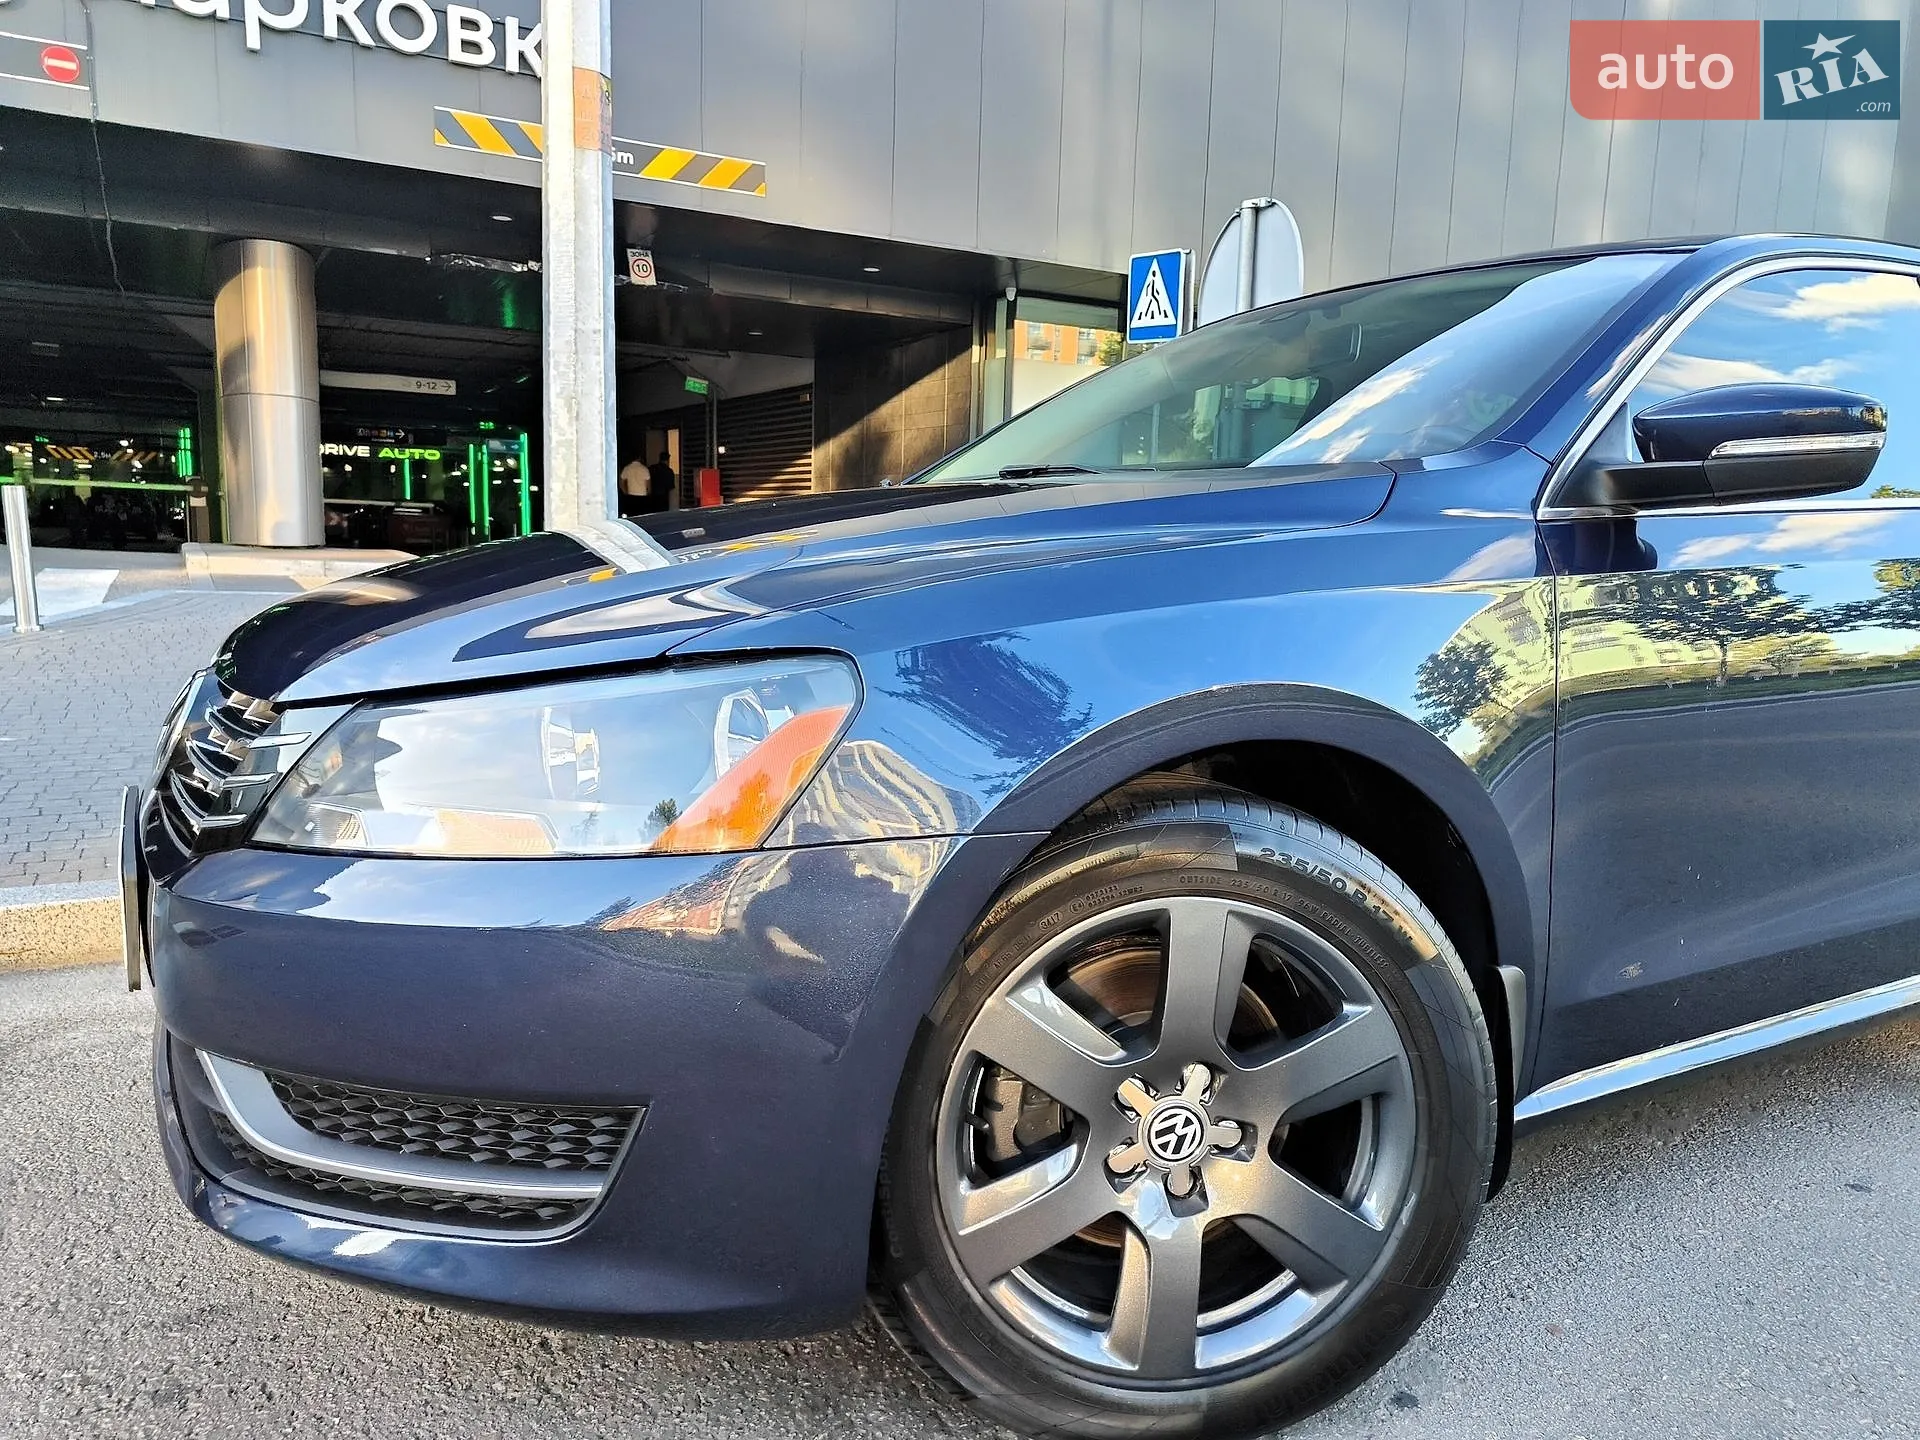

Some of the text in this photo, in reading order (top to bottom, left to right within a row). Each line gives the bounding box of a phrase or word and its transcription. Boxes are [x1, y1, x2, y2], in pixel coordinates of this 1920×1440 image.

[630, 250, 650, 258] ЗОНА
[636, 264, 648, 274] 10
[416, 380, 437, 390] 9-12
[378, 447, 441, 460] AUTO
[1180, 875, 1222, 885] OUTSIDE
[1231, 878, 1269, 894] 235/50
[1260, 847, 1348, 894] 235/50
[1350, 888, 1369, 911] R
[1039, 911, 1061, 931] 3417
